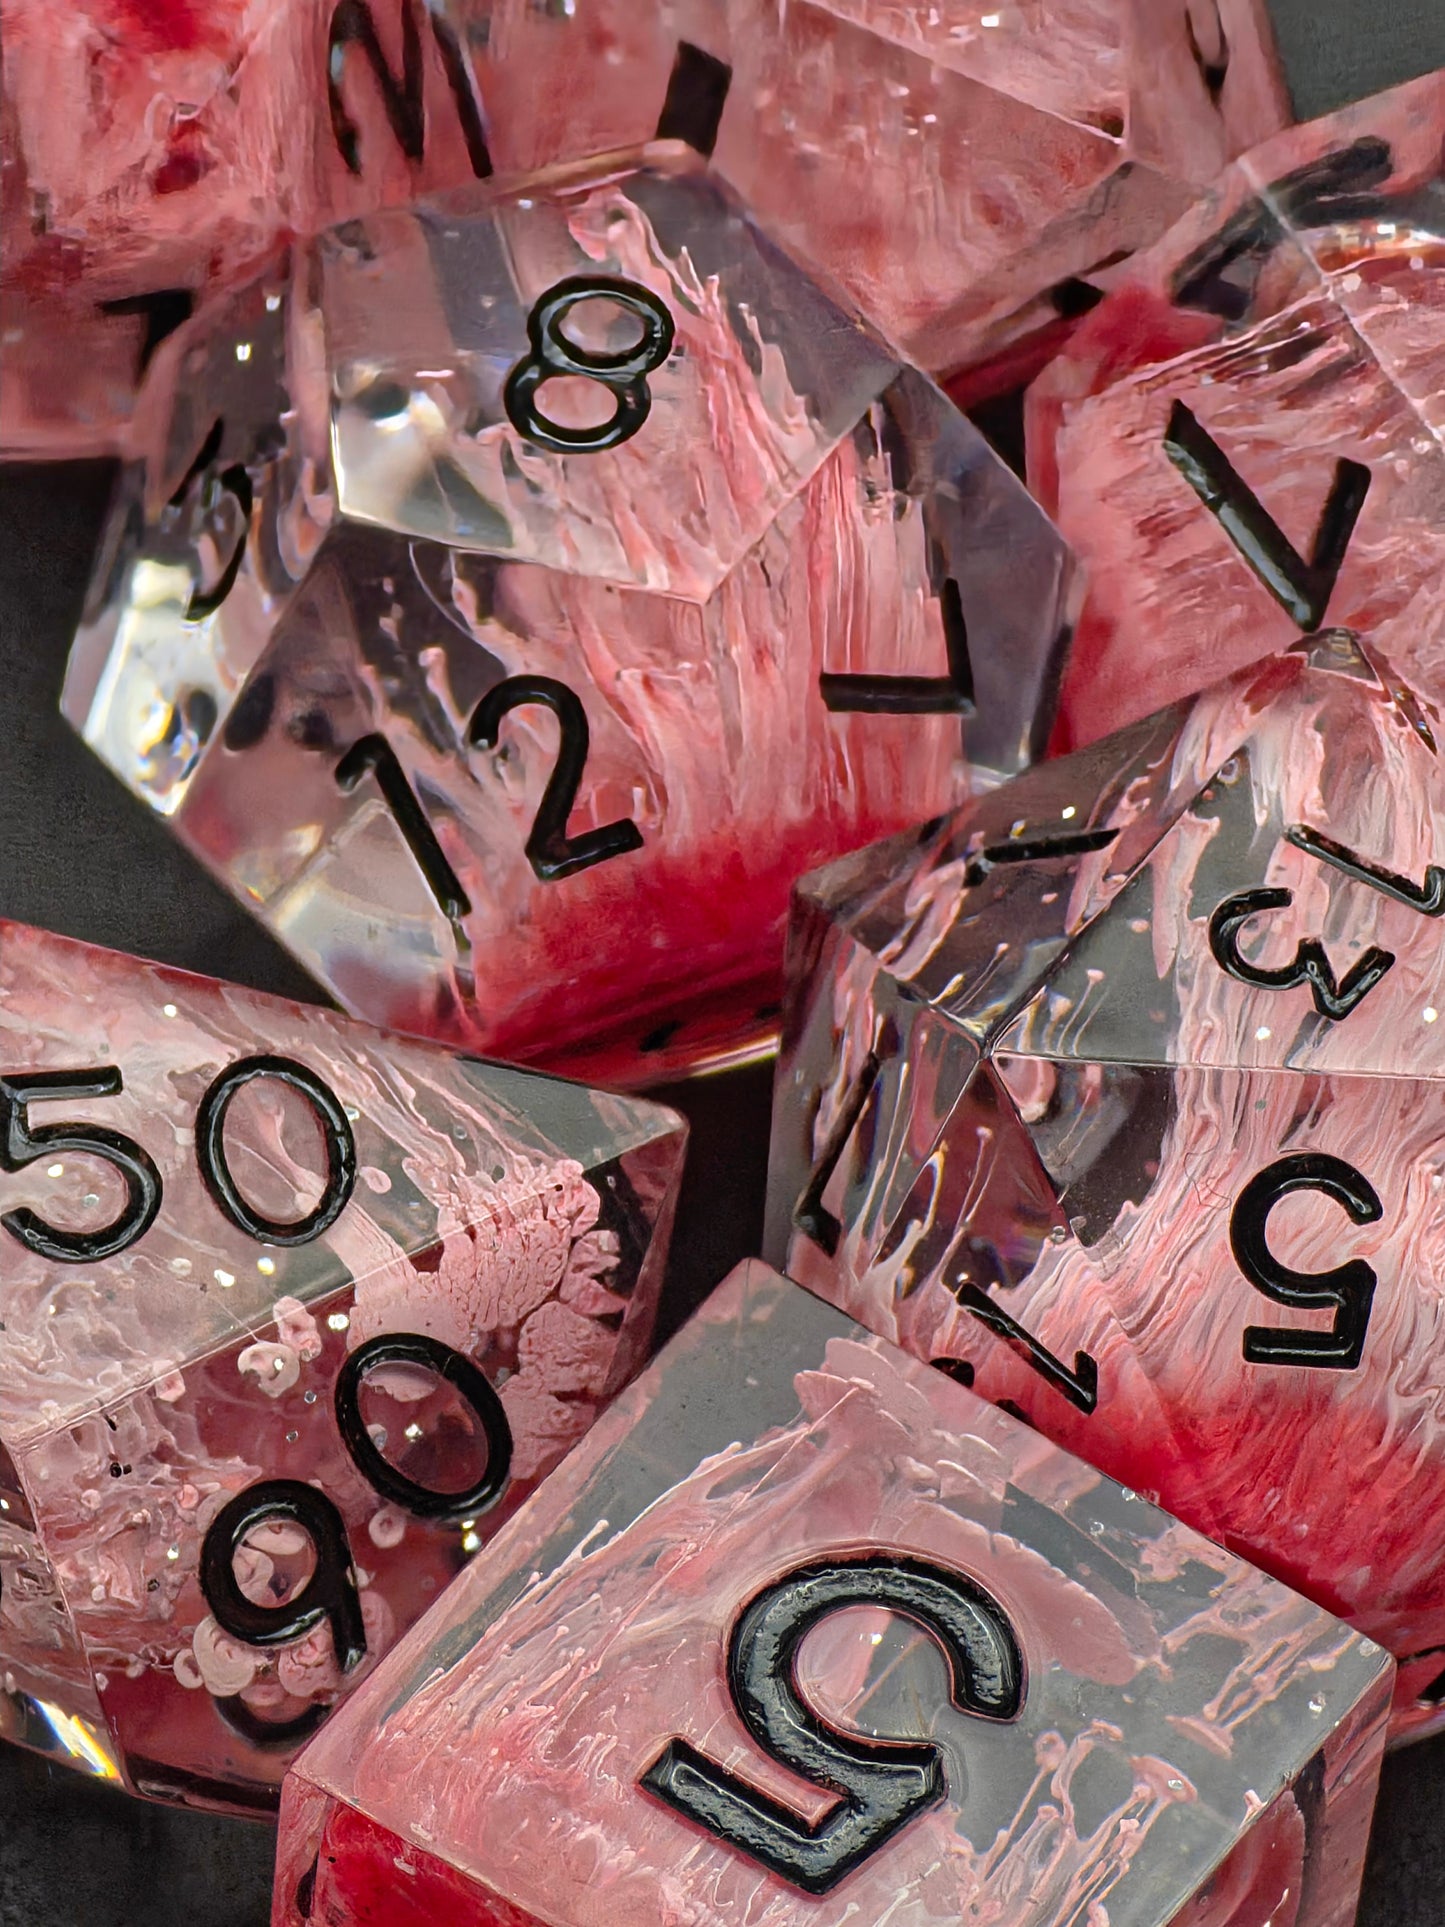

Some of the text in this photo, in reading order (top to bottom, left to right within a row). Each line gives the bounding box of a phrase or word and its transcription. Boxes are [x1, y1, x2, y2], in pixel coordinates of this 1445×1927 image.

[505, 274, 675, 454] 8
[335, 674, 643, 920] 12
[1209, 824, 1445, 1021] 13
[0, 1054, 356, 1263] 50
[1230, 1152, 1383, 1370] 5
[200, 1333, 514, 1675] 90
[639, 1555, 1026, 1896] 5
